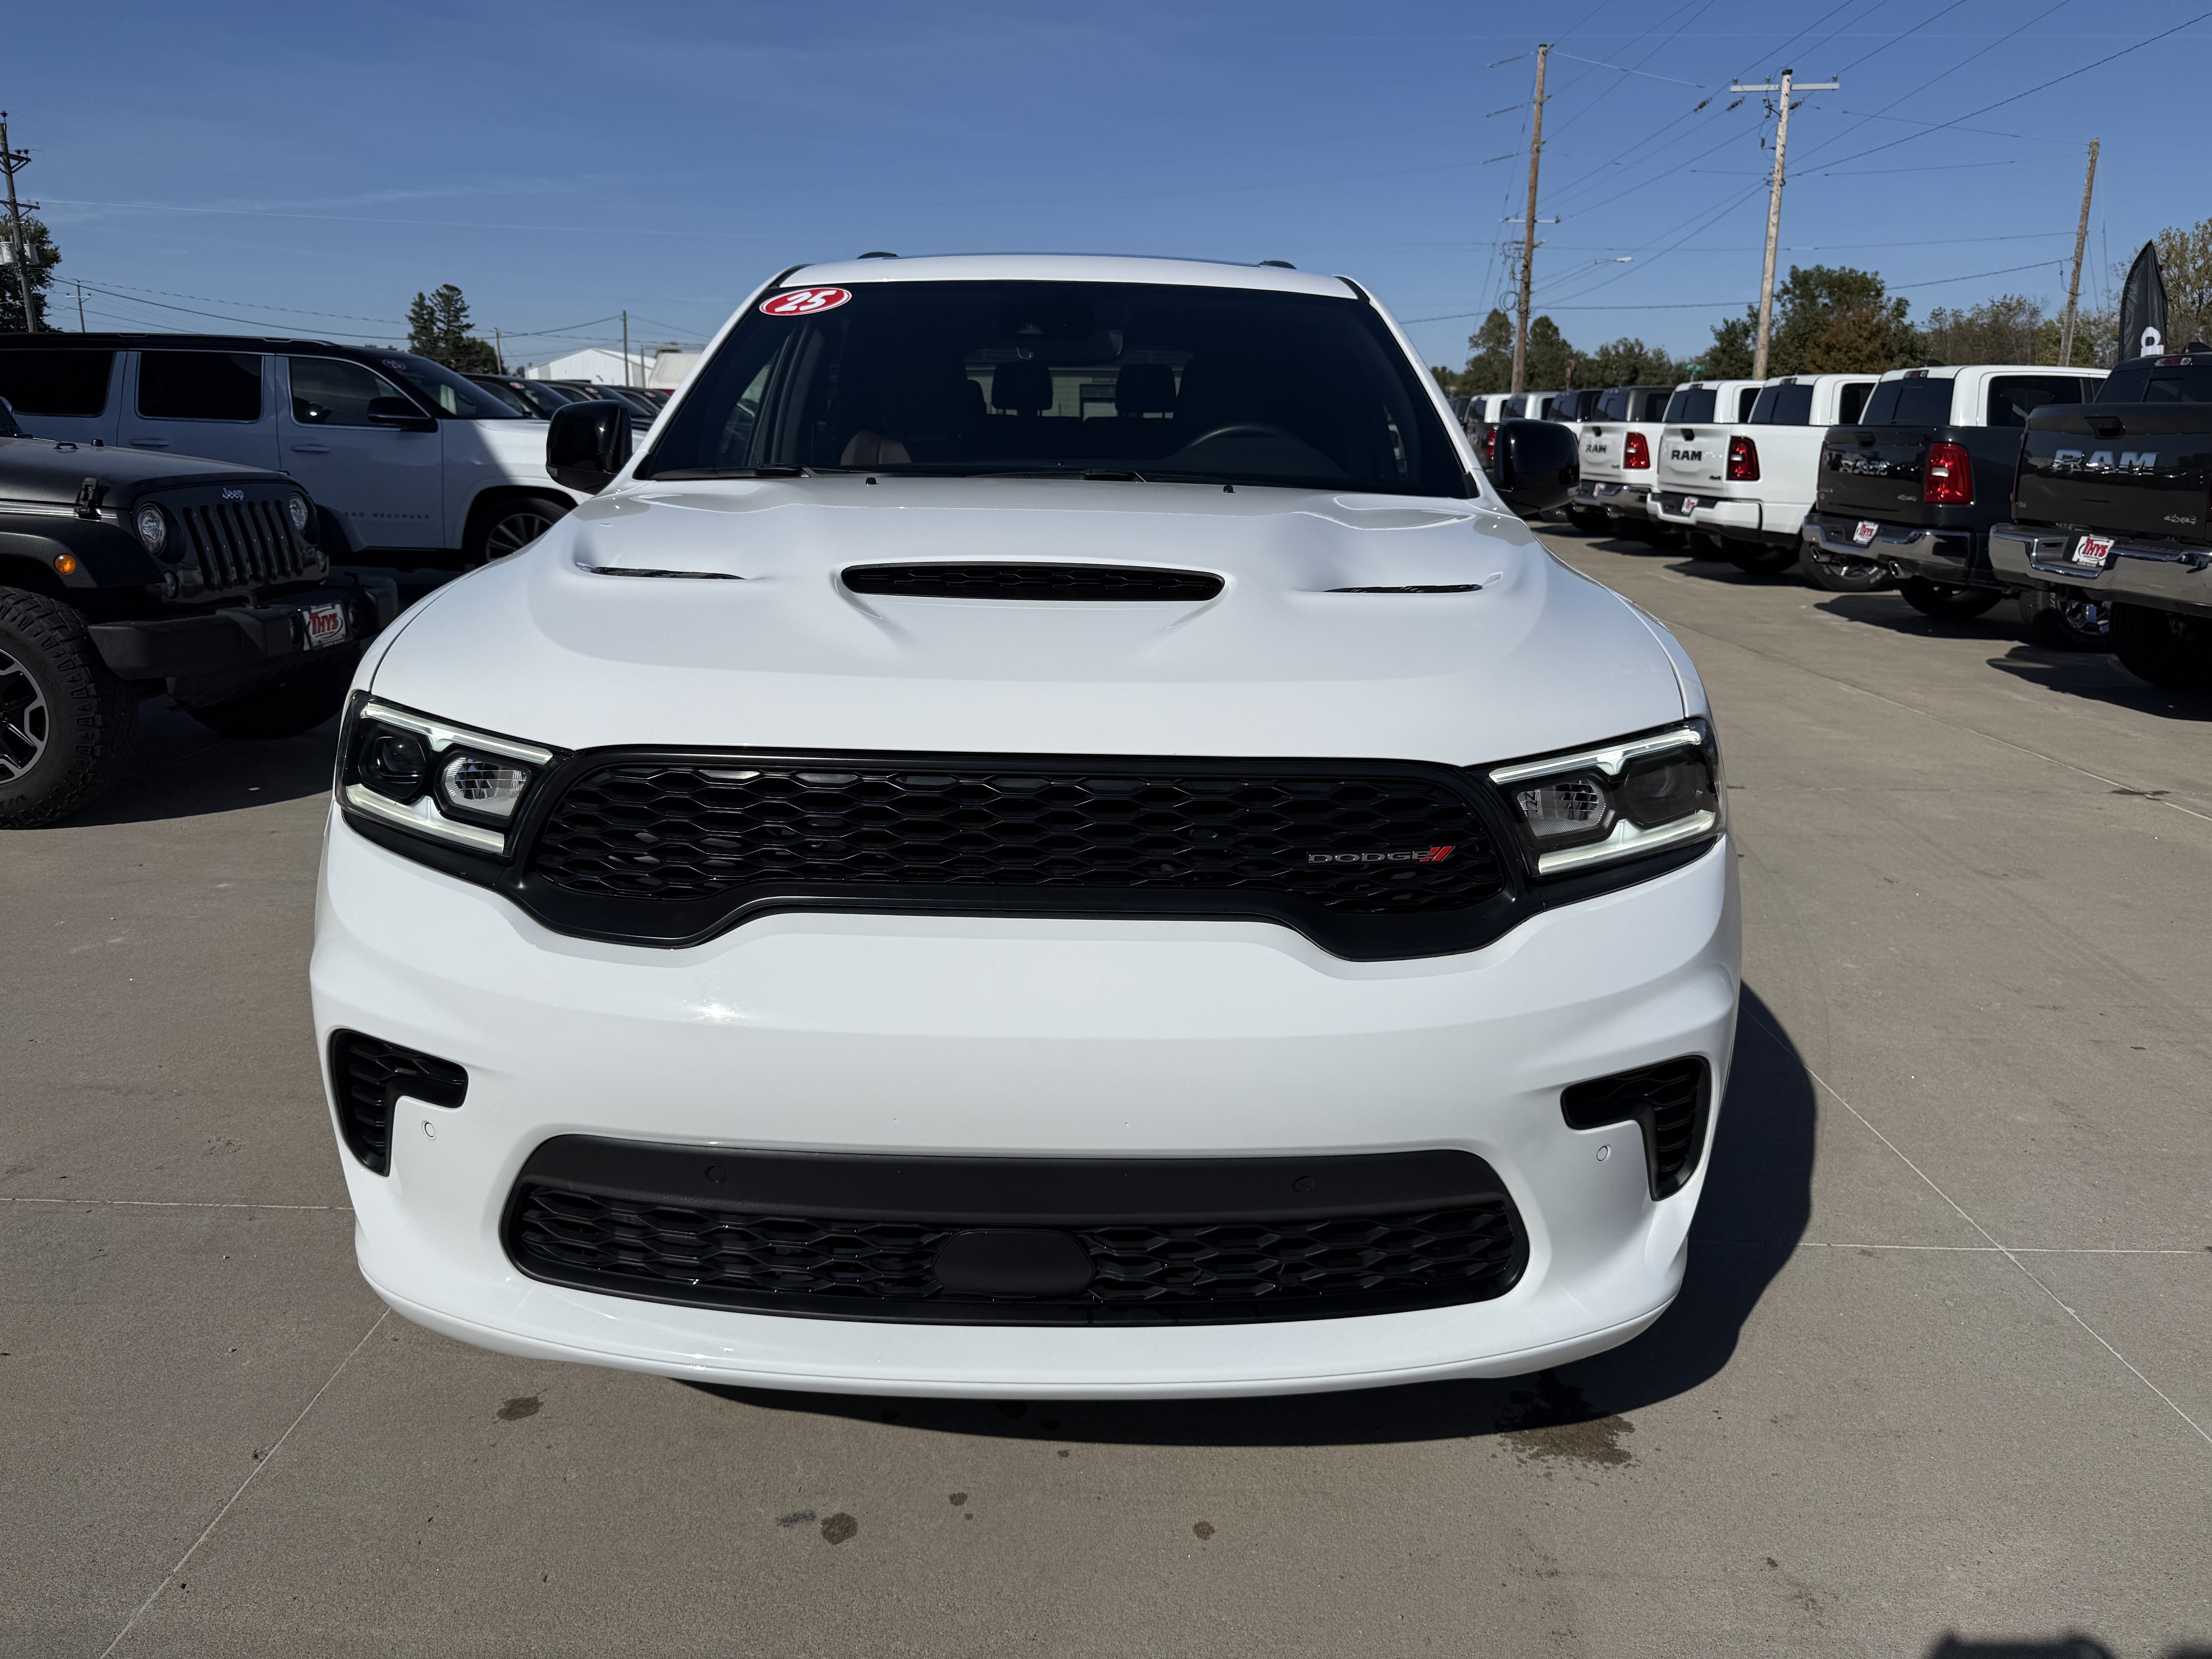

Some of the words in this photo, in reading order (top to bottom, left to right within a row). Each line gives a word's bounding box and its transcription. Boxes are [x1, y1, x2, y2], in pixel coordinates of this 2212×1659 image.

[775, 290, 837, 313] 25
[1671, 450, 1702, 462] RAM
[2052, 449, 2157, 475] RAM
[222, 488, 244, 500] Jeep
[2081, 539, 2108, 557] THYS
[310, 611, 339, 635] THYS
[1308, 851, 1435, 863] DODGE
